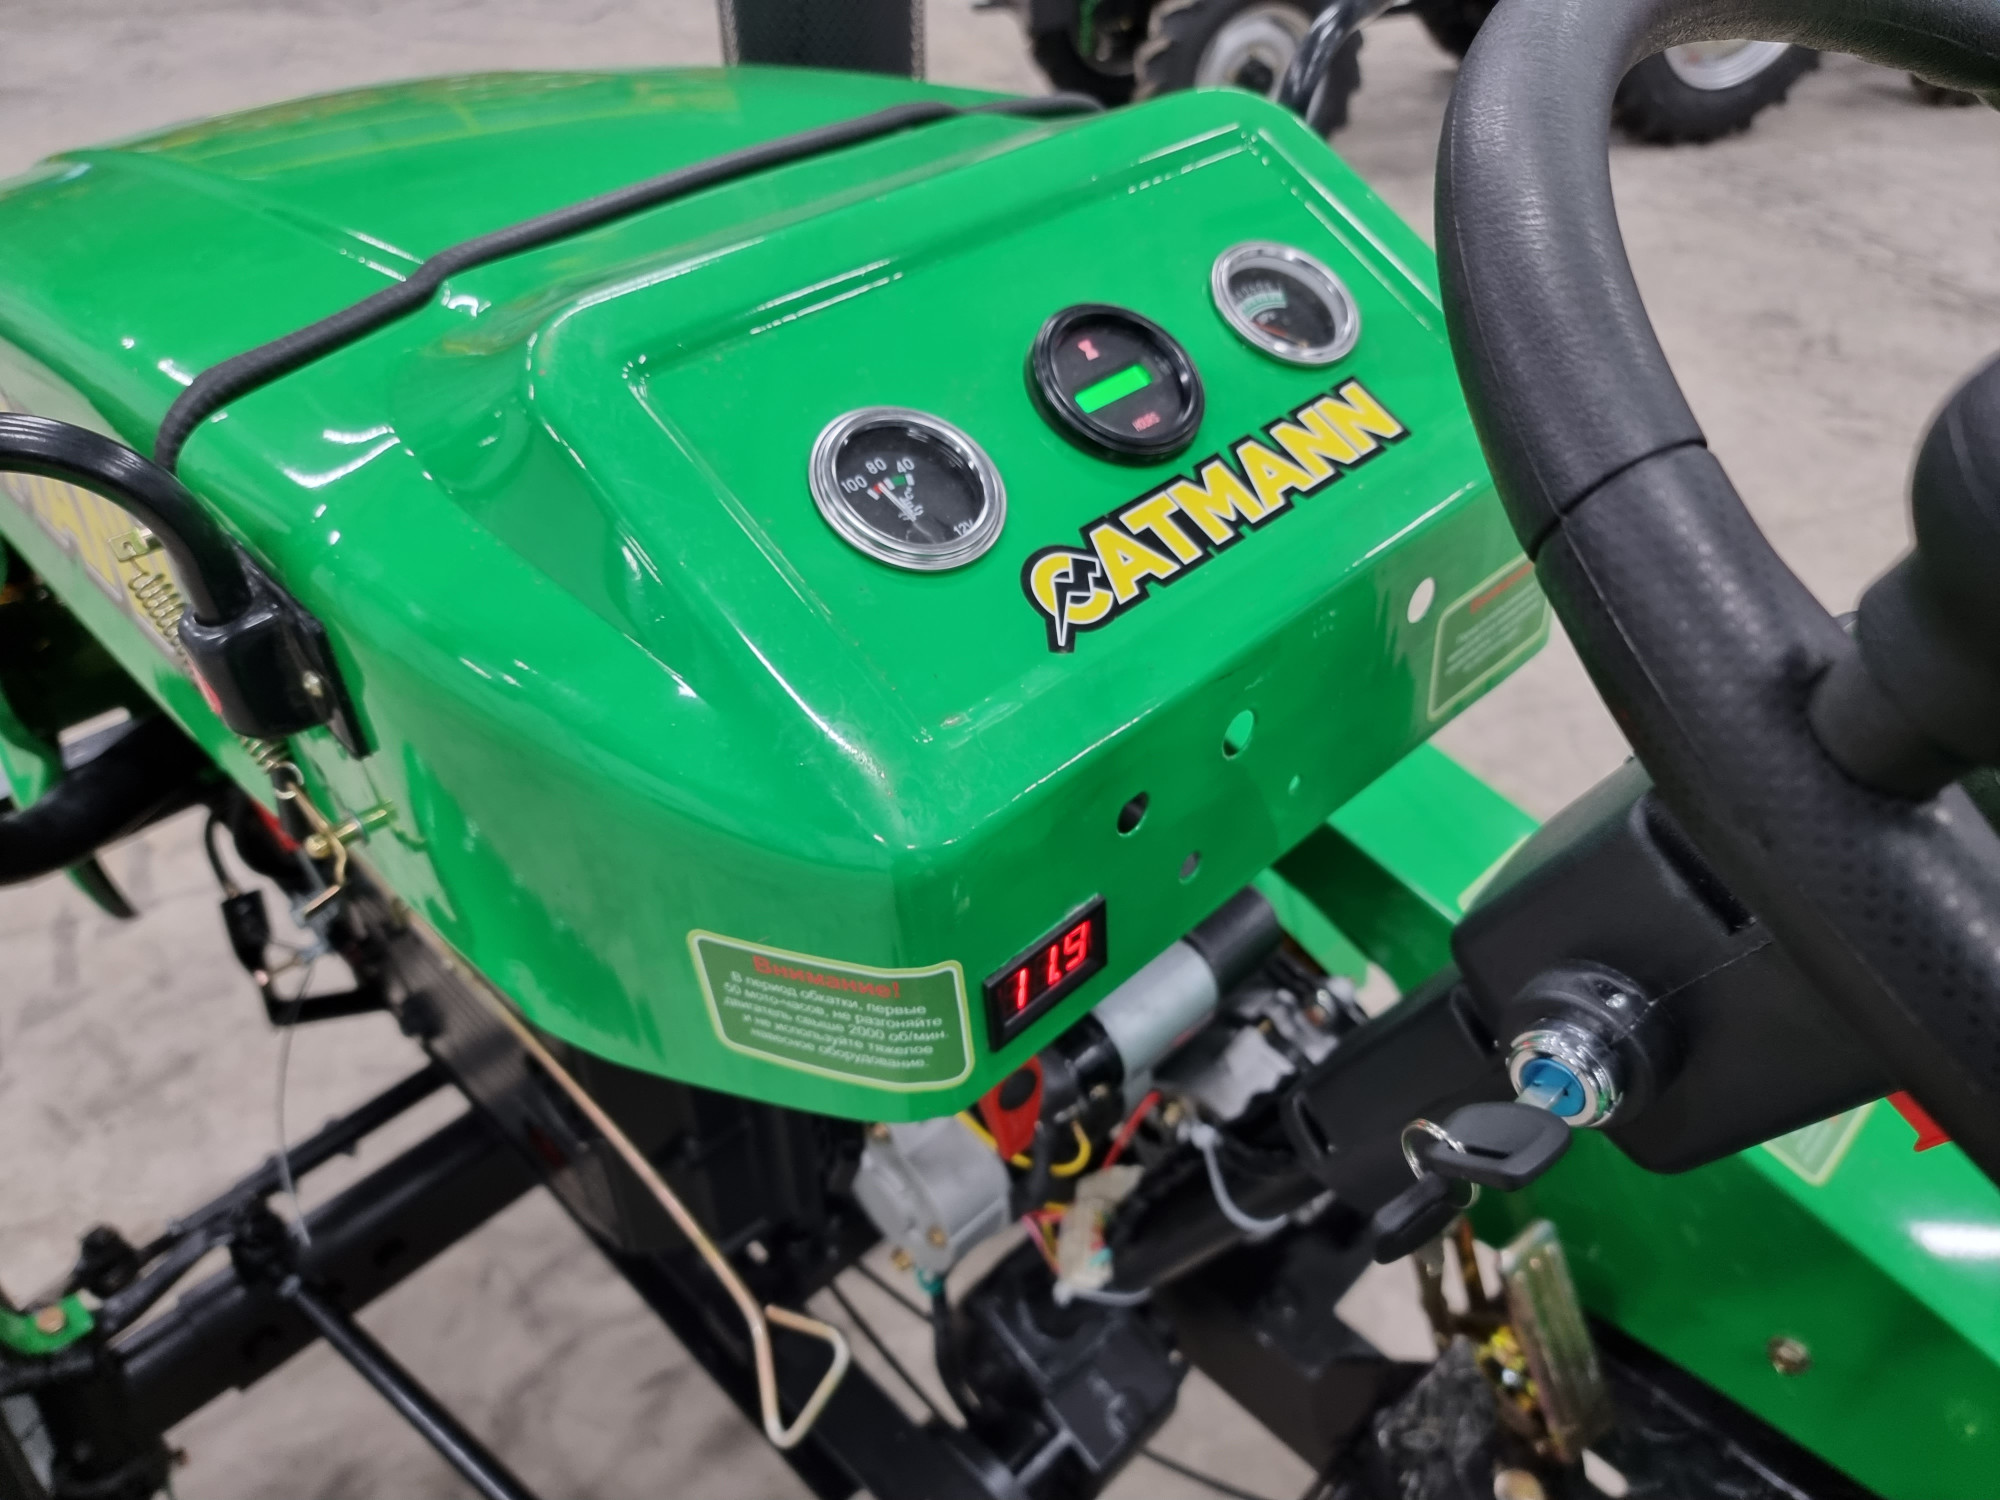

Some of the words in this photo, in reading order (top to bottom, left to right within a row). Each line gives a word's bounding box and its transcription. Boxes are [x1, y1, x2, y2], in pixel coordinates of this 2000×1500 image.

[841, 474, 868, 494] 100
[865, 457, 887, 475] 80
[896, 457, 915, 474] 40
[730, 970, 743, 983] В
[745, 976, 798, 998] период
[800, 989, 863, 1011] обкатки,
[866, 1002, 927, 1017] первые
[753, 955, 900, 998] Внимание!
[723, 981, 742, 996] 50
[832, 1010, 851, 1020] не
[855, 1014, 943, 1029] разгоняйте
[723, 996, 793, 1021] двигатель
[795, 1014, 845, 1033] свыше
[848, 1023, 885, 1041] 2000
[743, 1013, 752, 1023] и
[754, 1016, 772, 1028] не
[774, 1022, 864, 1049] используйте
[868, 1042, 934, 1056] тяжелое
[750, 1027, 816, 1052] навесное
